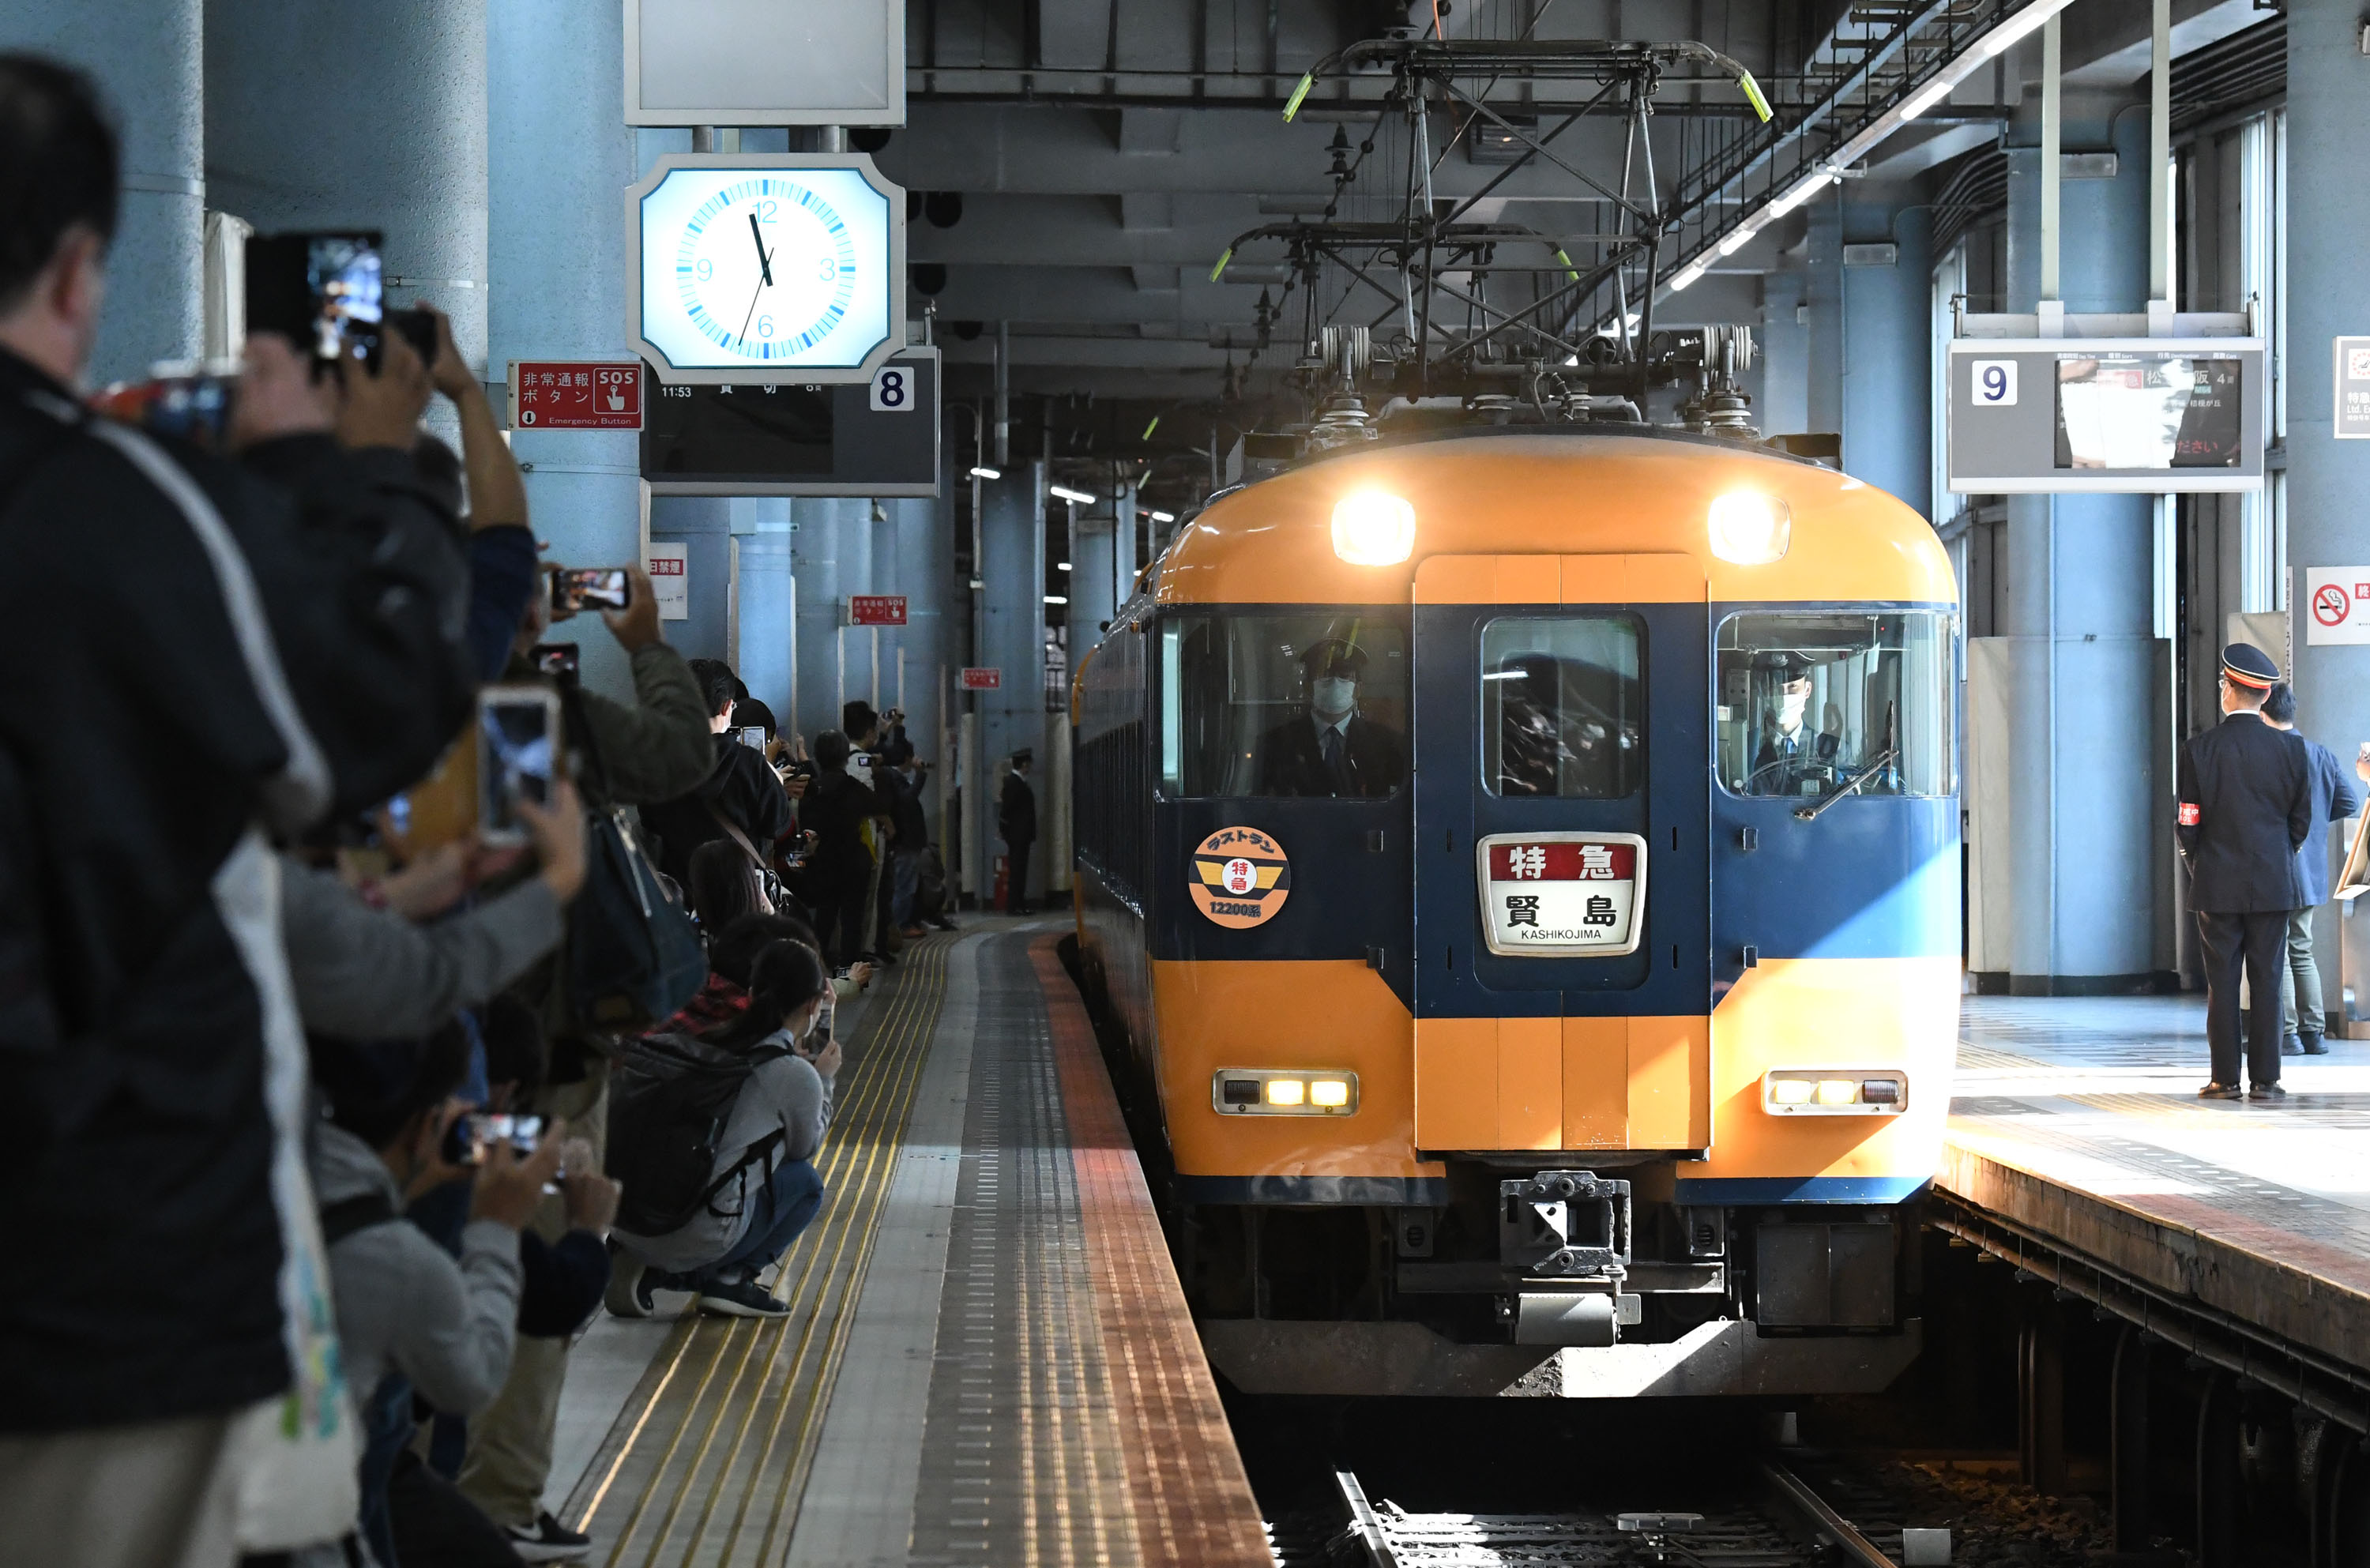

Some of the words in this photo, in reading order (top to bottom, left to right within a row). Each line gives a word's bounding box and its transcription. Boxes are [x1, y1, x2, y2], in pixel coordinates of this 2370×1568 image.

[751, 201, 777, 223] 12
[697, 258, 713, 281] 9
[819, 258, 835, 281] 3
[758, 314, 773, 338] 6
[524, 372, 589, 387] 非常通報
[599, 371, 634, 385] SOS
[880, 371, 905, 407] 8
[1983, 365, 2007, 401] 9
[523, 389, 589, 404] ボタン
[661, 386, 691, 397] 11:53
[2347, 404, 2362, 414] Ltd.
[1206, 829, 1274, 853] ラストラン
[1509, 845, 1615, 879] 特急
[1231, 861, 1248, 891] 特急
[1209, 901, 1262, 918] 12200系
[1506, 894, 1617, 927] 賢島
[1522, 929, 1602, 940] KASHIKOJIMA
